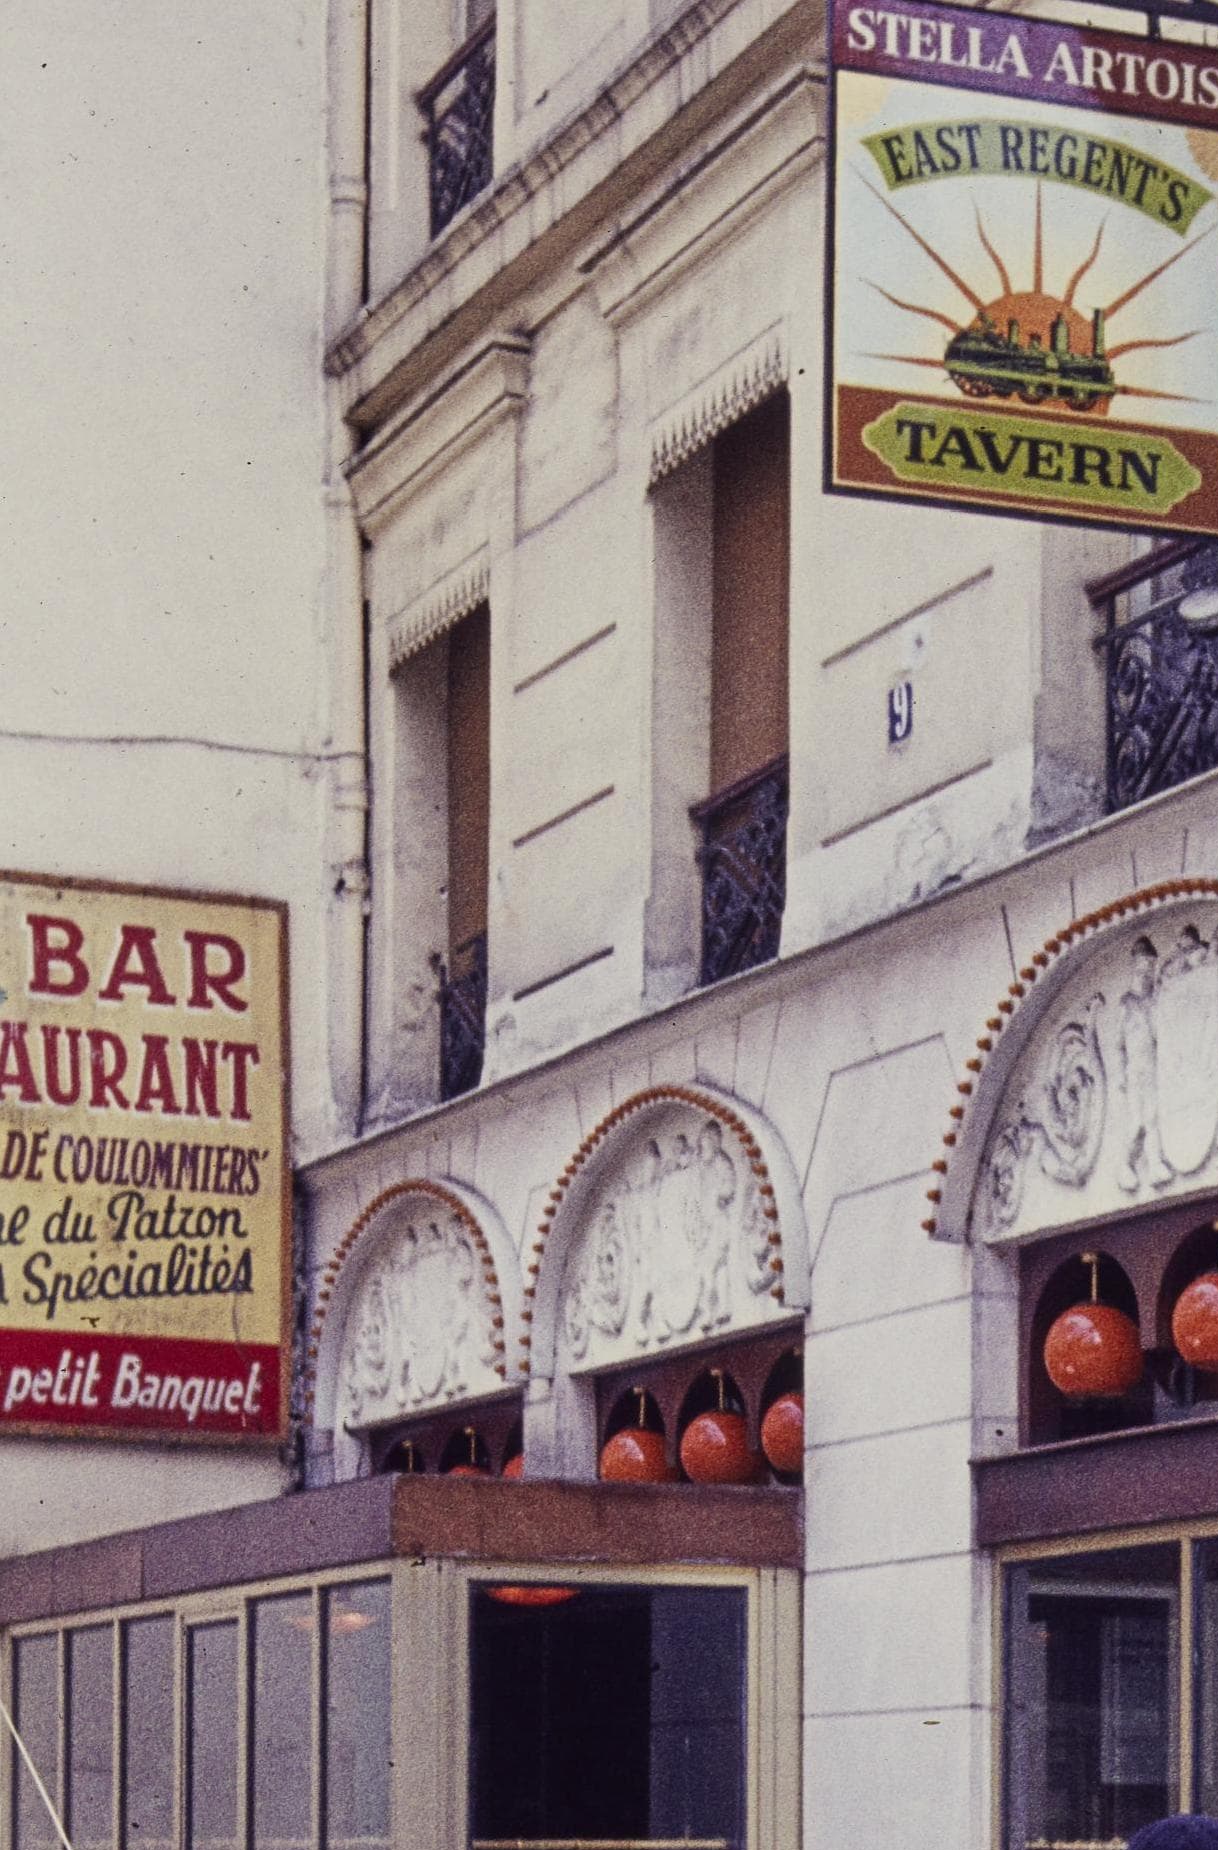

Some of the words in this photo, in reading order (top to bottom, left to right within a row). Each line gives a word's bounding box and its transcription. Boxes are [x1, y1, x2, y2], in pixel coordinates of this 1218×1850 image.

[847, 8, 1031, 78] STELLA
[882, 124, 982, 184] EAST
[1001, 124, 1190, 226] REGENT'S
[896, 418, 1163, 495] TAVERN
[892, 681, 910, 740] 9
[26, 913, 249, 1013] BAR
[0, 1129, 49, 1182] DE
[43, 1195, 97, 1244] du
[108, 1190, 248, 1243] Patron
[4, 1349, 101, 1413] petit
[111, 1354, 262, 1425] Banquet
